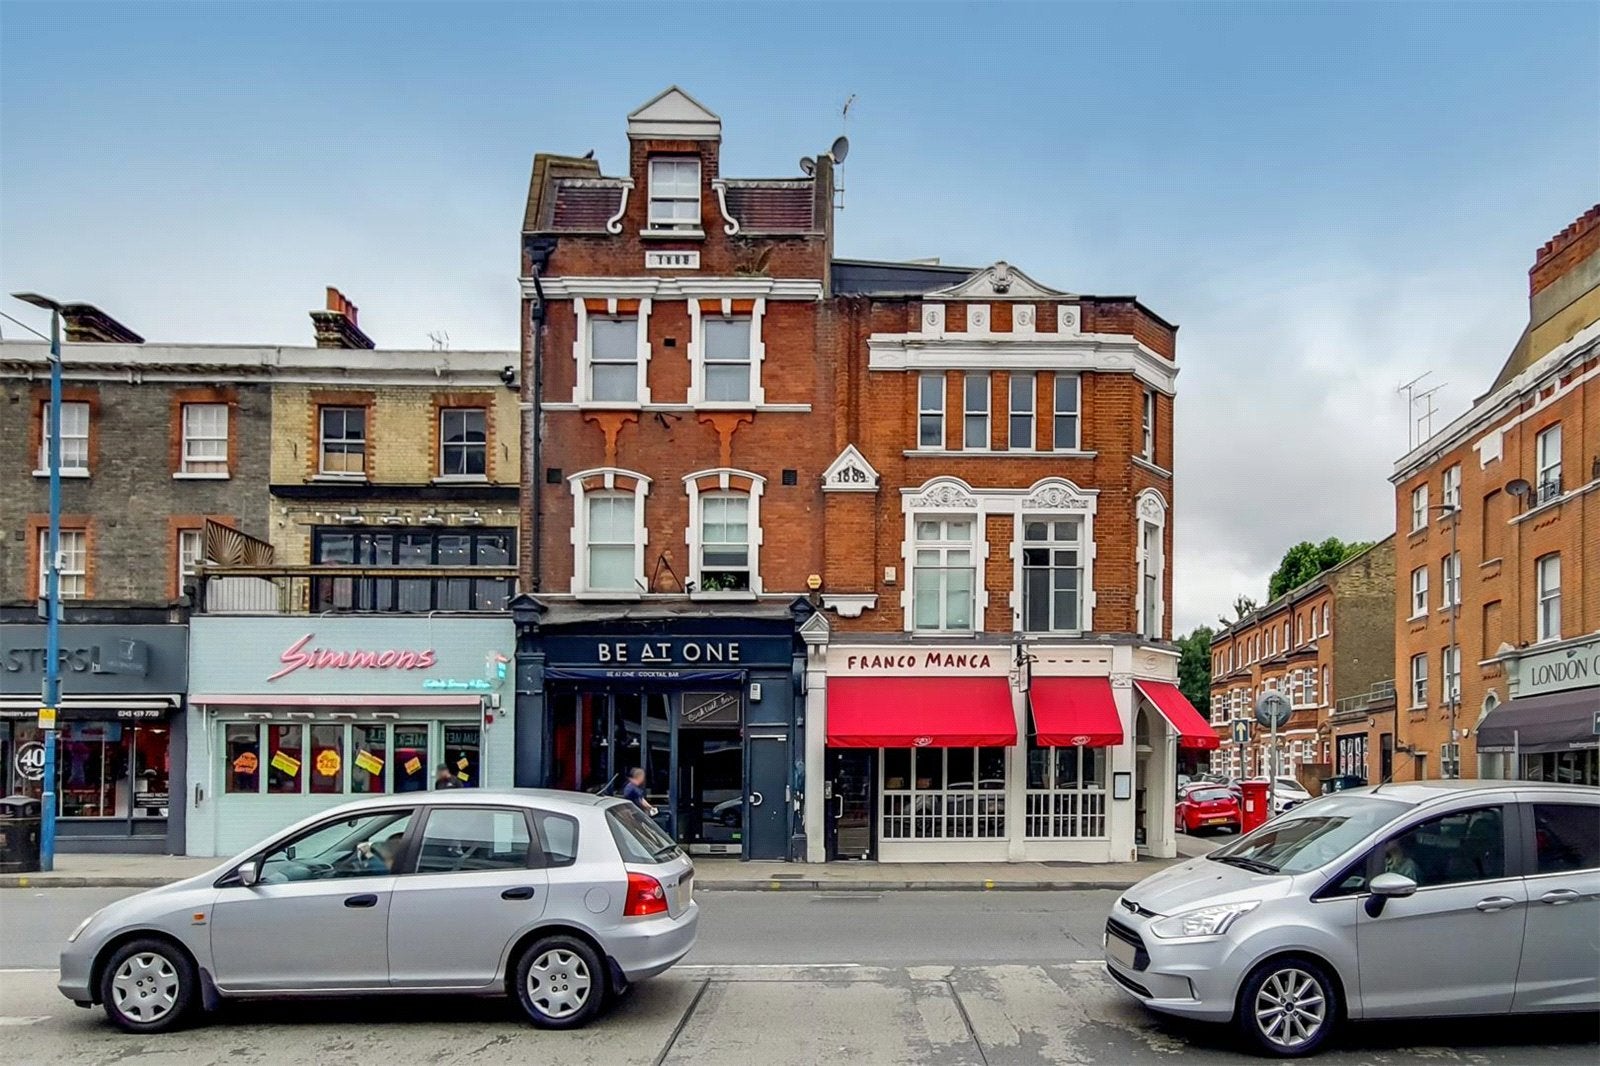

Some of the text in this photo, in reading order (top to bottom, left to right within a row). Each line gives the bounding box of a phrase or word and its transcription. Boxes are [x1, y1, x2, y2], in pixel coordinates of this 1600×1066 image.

[838, 466, 866, 482] 1889
[266, 633, 437, 682] Simmons
[598, 643, 740, 661] BE AT ONE
[847, 653, 990, 669] FRANCO MANCA
[1531, 658, 1588, 686] LONDON
[20, 748, 46, 767] 40
